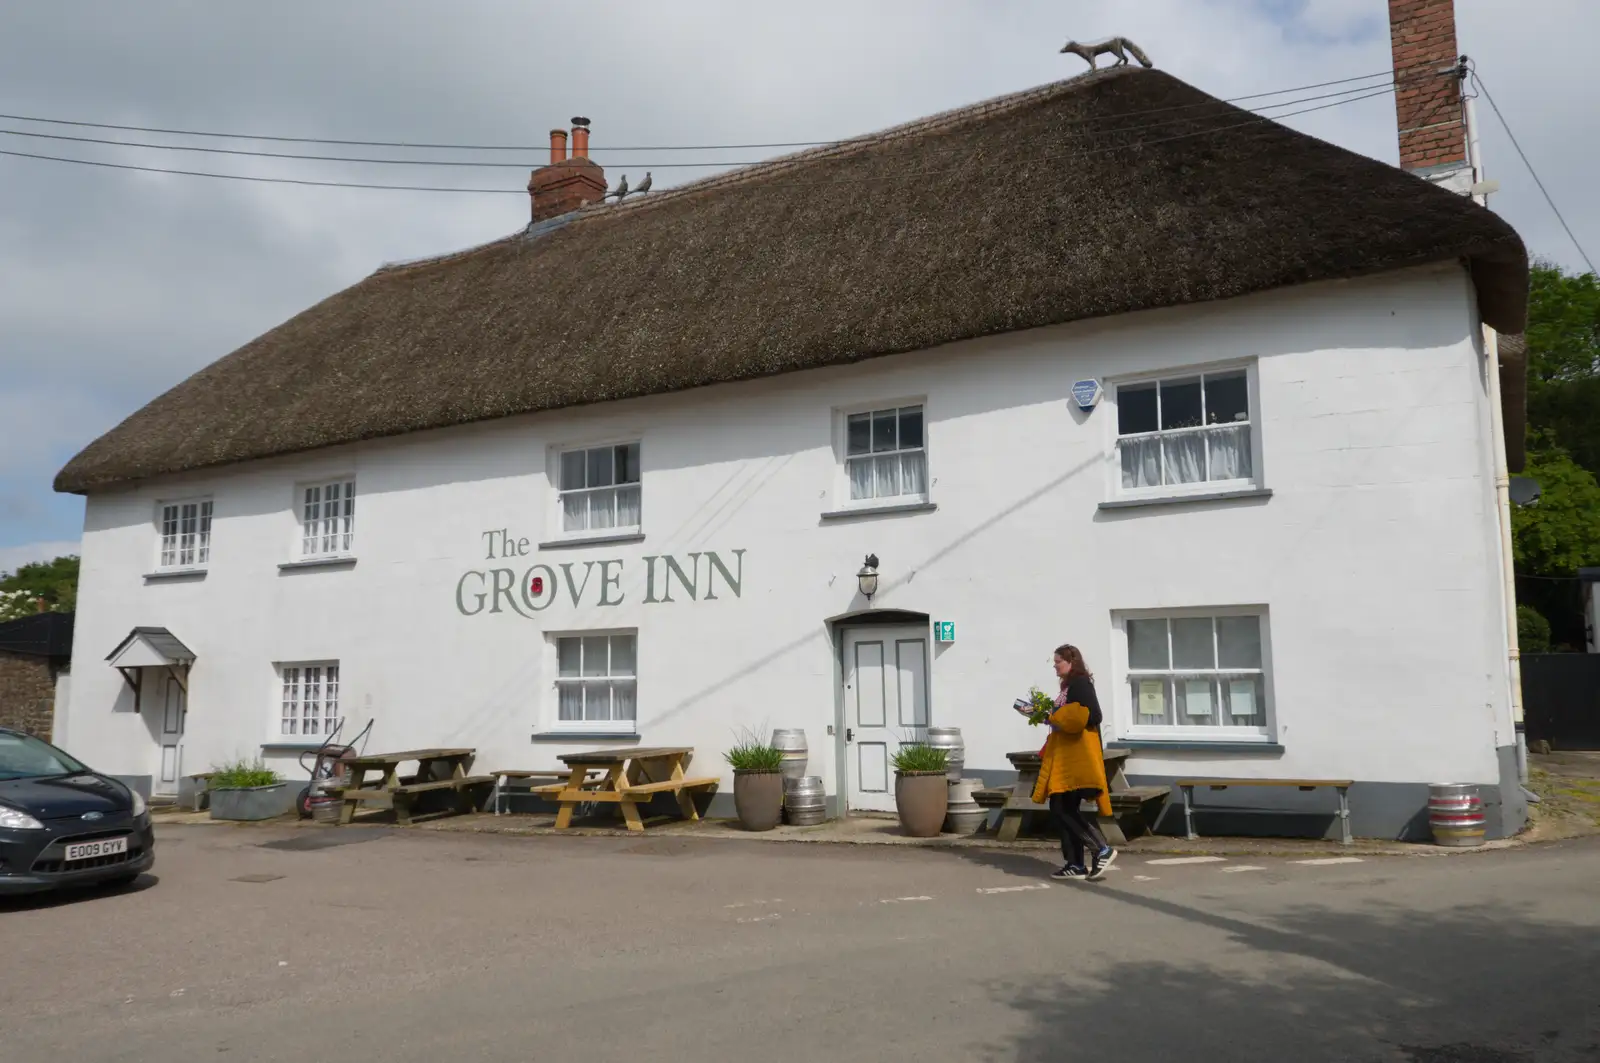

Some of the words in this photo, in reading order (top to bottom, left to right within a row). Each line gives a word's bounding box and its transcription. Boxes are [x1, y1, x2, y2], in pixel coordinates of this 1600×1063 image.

[482, 528, 530, 560] The
[456, 559, 626, 619] GROVE
[642, 548, 747, 605] INN
[103, 841, 122, 853] GYV
